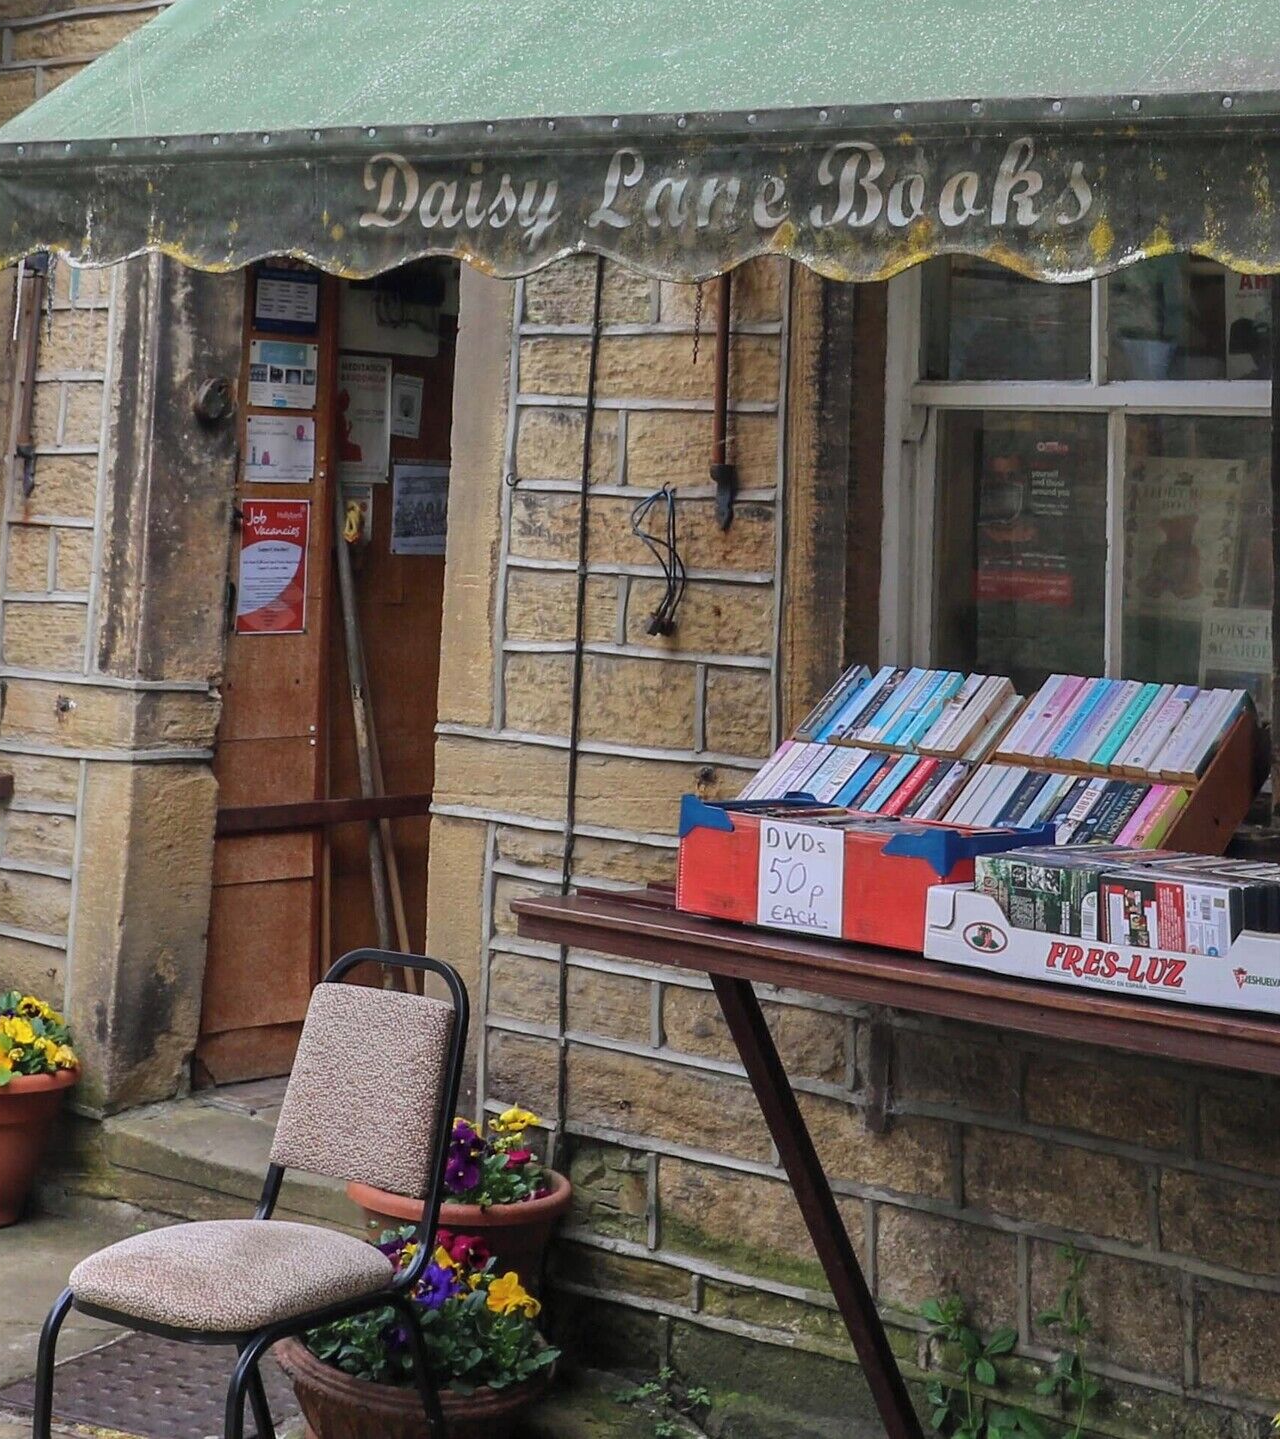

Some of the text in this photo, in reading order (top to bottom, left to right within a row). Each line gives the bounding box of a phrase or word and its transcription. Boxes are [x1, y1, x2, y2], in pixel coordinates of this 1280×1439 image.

[360, 138, 1094, 242] Daisy Lane Books
[246, 507, 268, 527] Job
[254, 525, 300, 538] Vacancies
[1071, 790, 1097, 818] BEAUTY
[1107, 787, 1144, 836] KATE MORTON
[767, 827, 826, 853] DVDs
[771, 905, 818, 926] EACH
[1046, 941, 1187, 988] FRES-LUZ
[1084, 974, 1116, 986] PRODUCIDO
[1125, 980, 1147, 991] ESPAÑA
